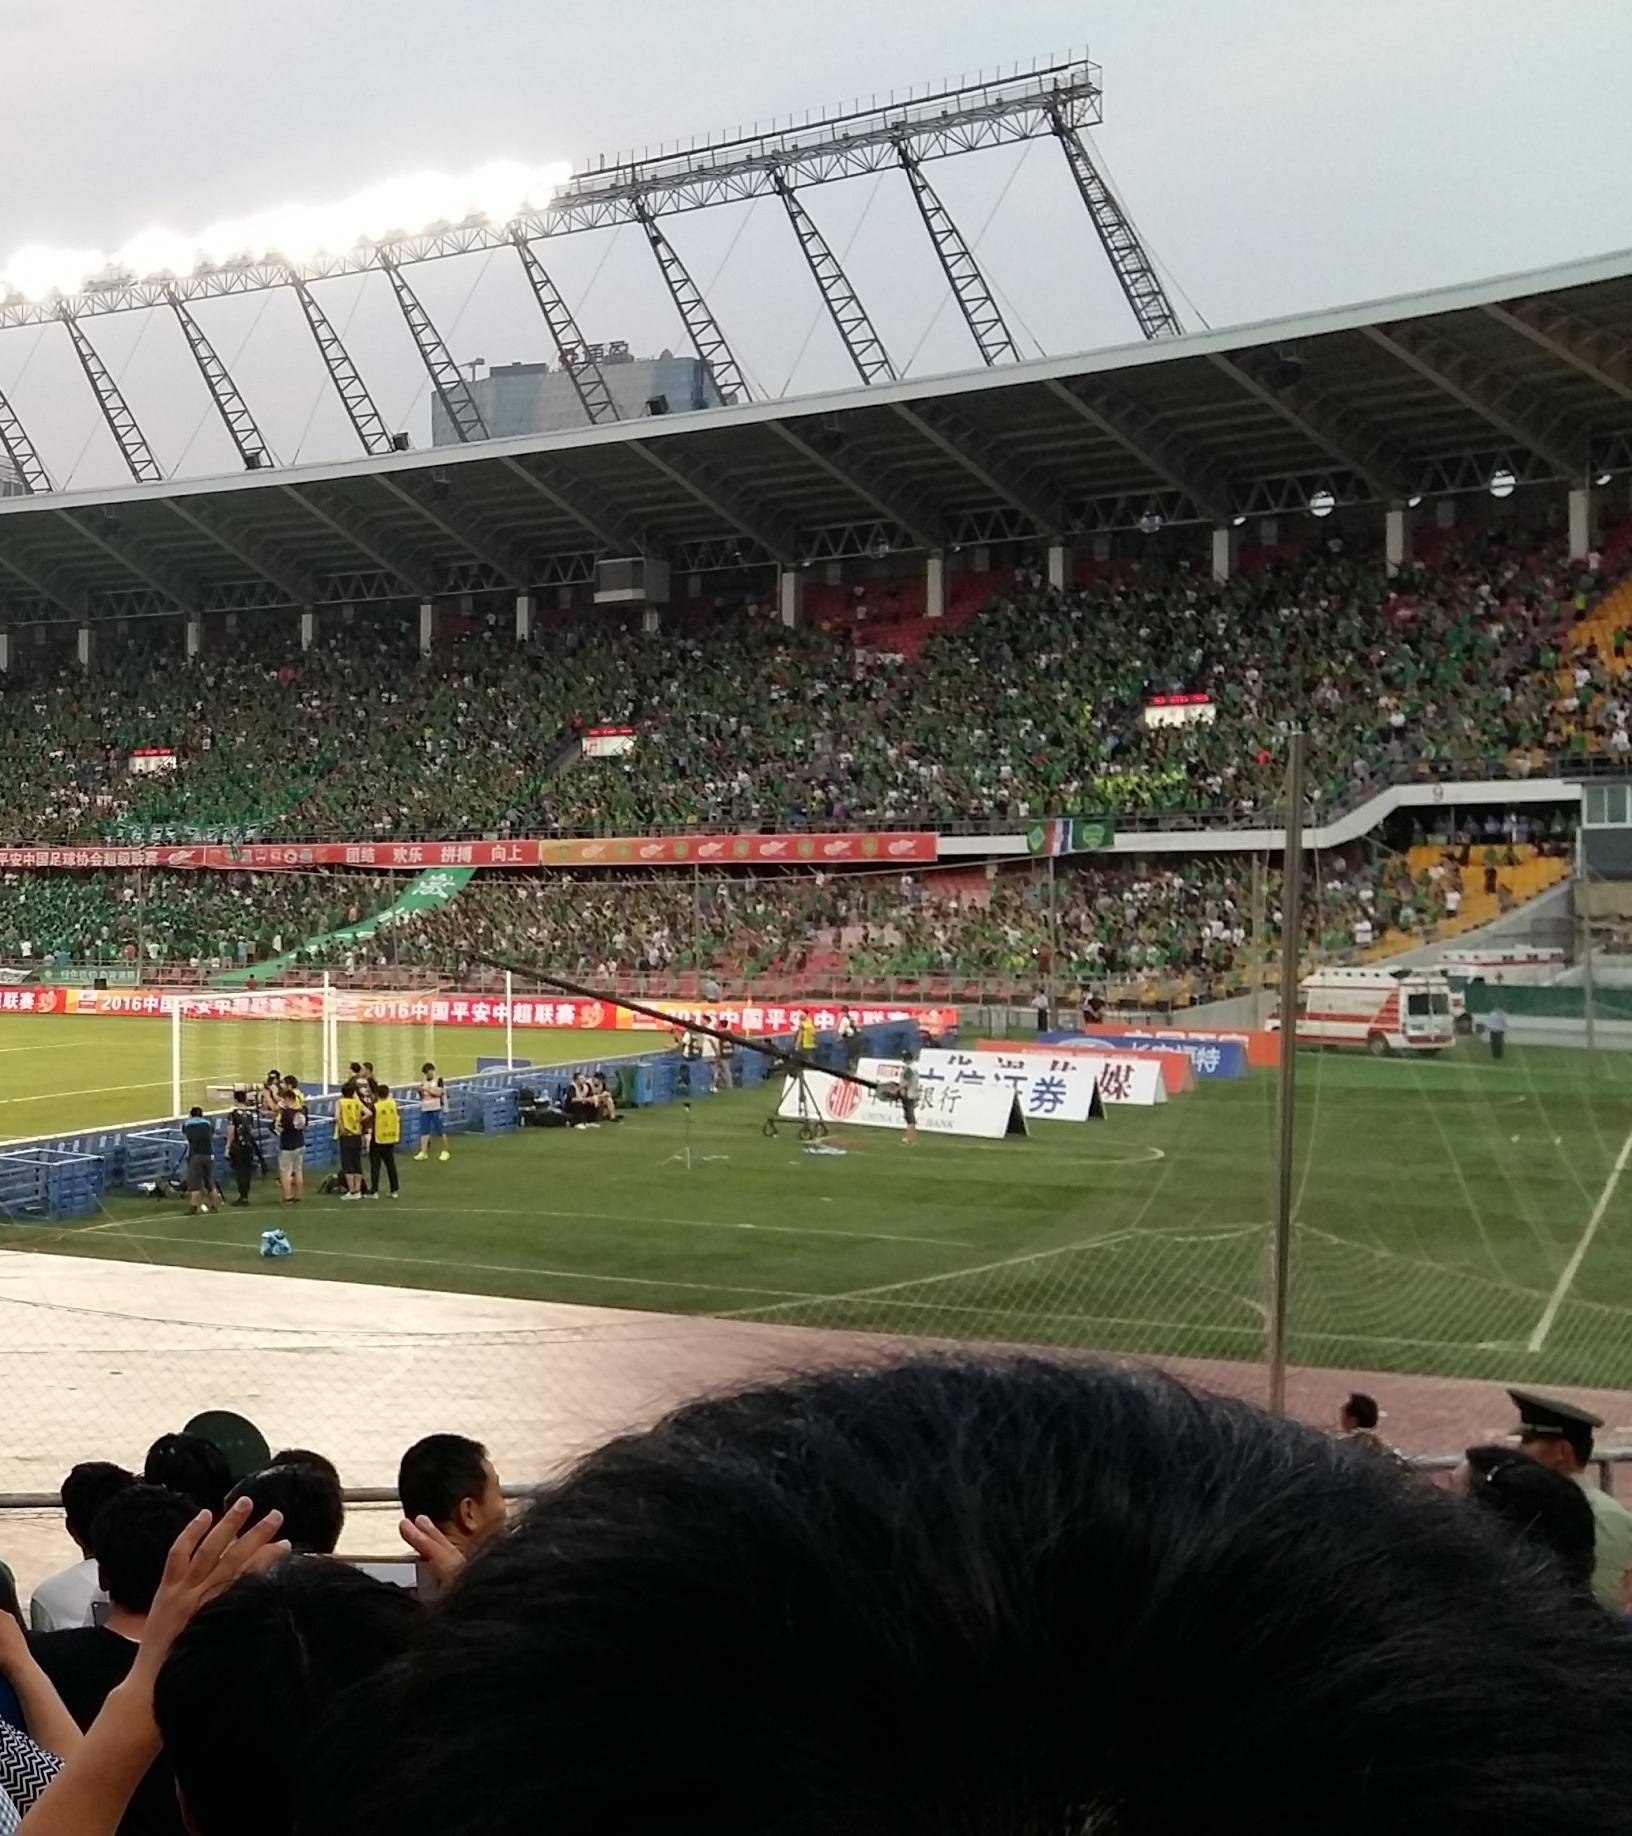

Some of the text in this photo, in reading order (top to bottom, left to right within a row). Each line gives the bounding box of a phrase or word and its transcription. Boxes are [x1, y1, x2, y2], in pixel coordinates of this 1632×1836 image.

[346, 845, 523, 863] 团结 欢乐 拼搏 向上
[363, 1001, 575, 1024] 2016中国平安中超联赛
